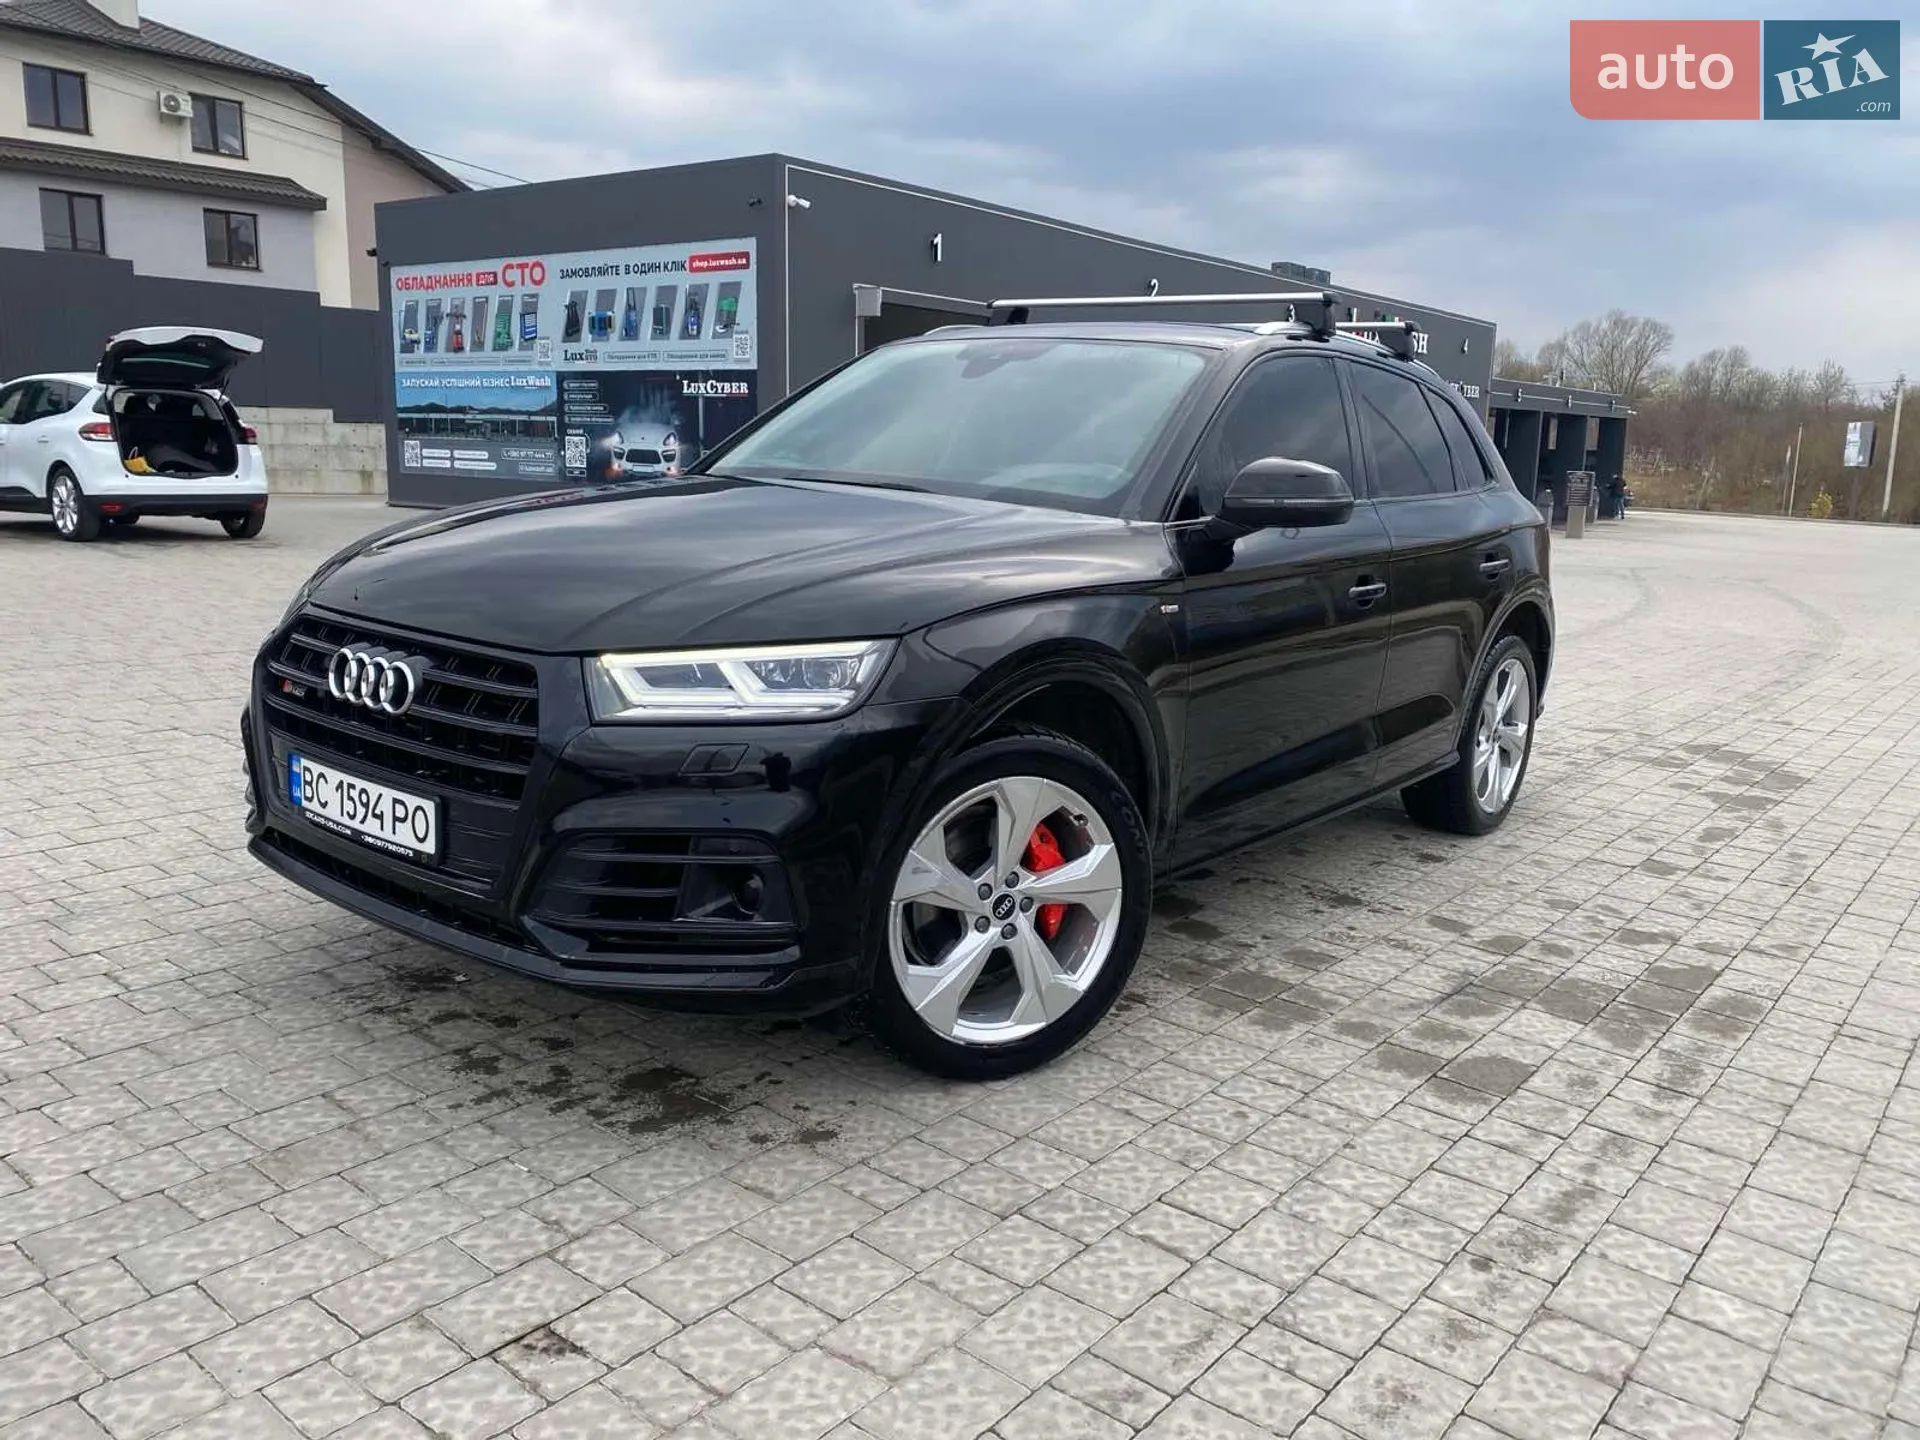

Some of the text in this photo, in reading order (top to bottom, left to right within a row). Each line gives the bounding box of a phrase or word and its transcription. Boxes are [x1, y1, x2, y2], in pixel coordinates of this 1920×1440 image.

[933, 232, 943, 262] 1
[395, 272, 474, 292] ОБЛАДНАННЯ
[501, 260, 546, 288] СТО
[559, 259, 687, 280] ЗАМОВЛЯЙТЕ В ОДИН КЛІК
[402, 377, 440, 387] ЗАПУСКАЙ
[441, 376, 481, 387] УСПІШНИЙ
[482, 378, 510, 387] БІЗНЕС
[302, 764, 430, 844] BC 1594 PO
